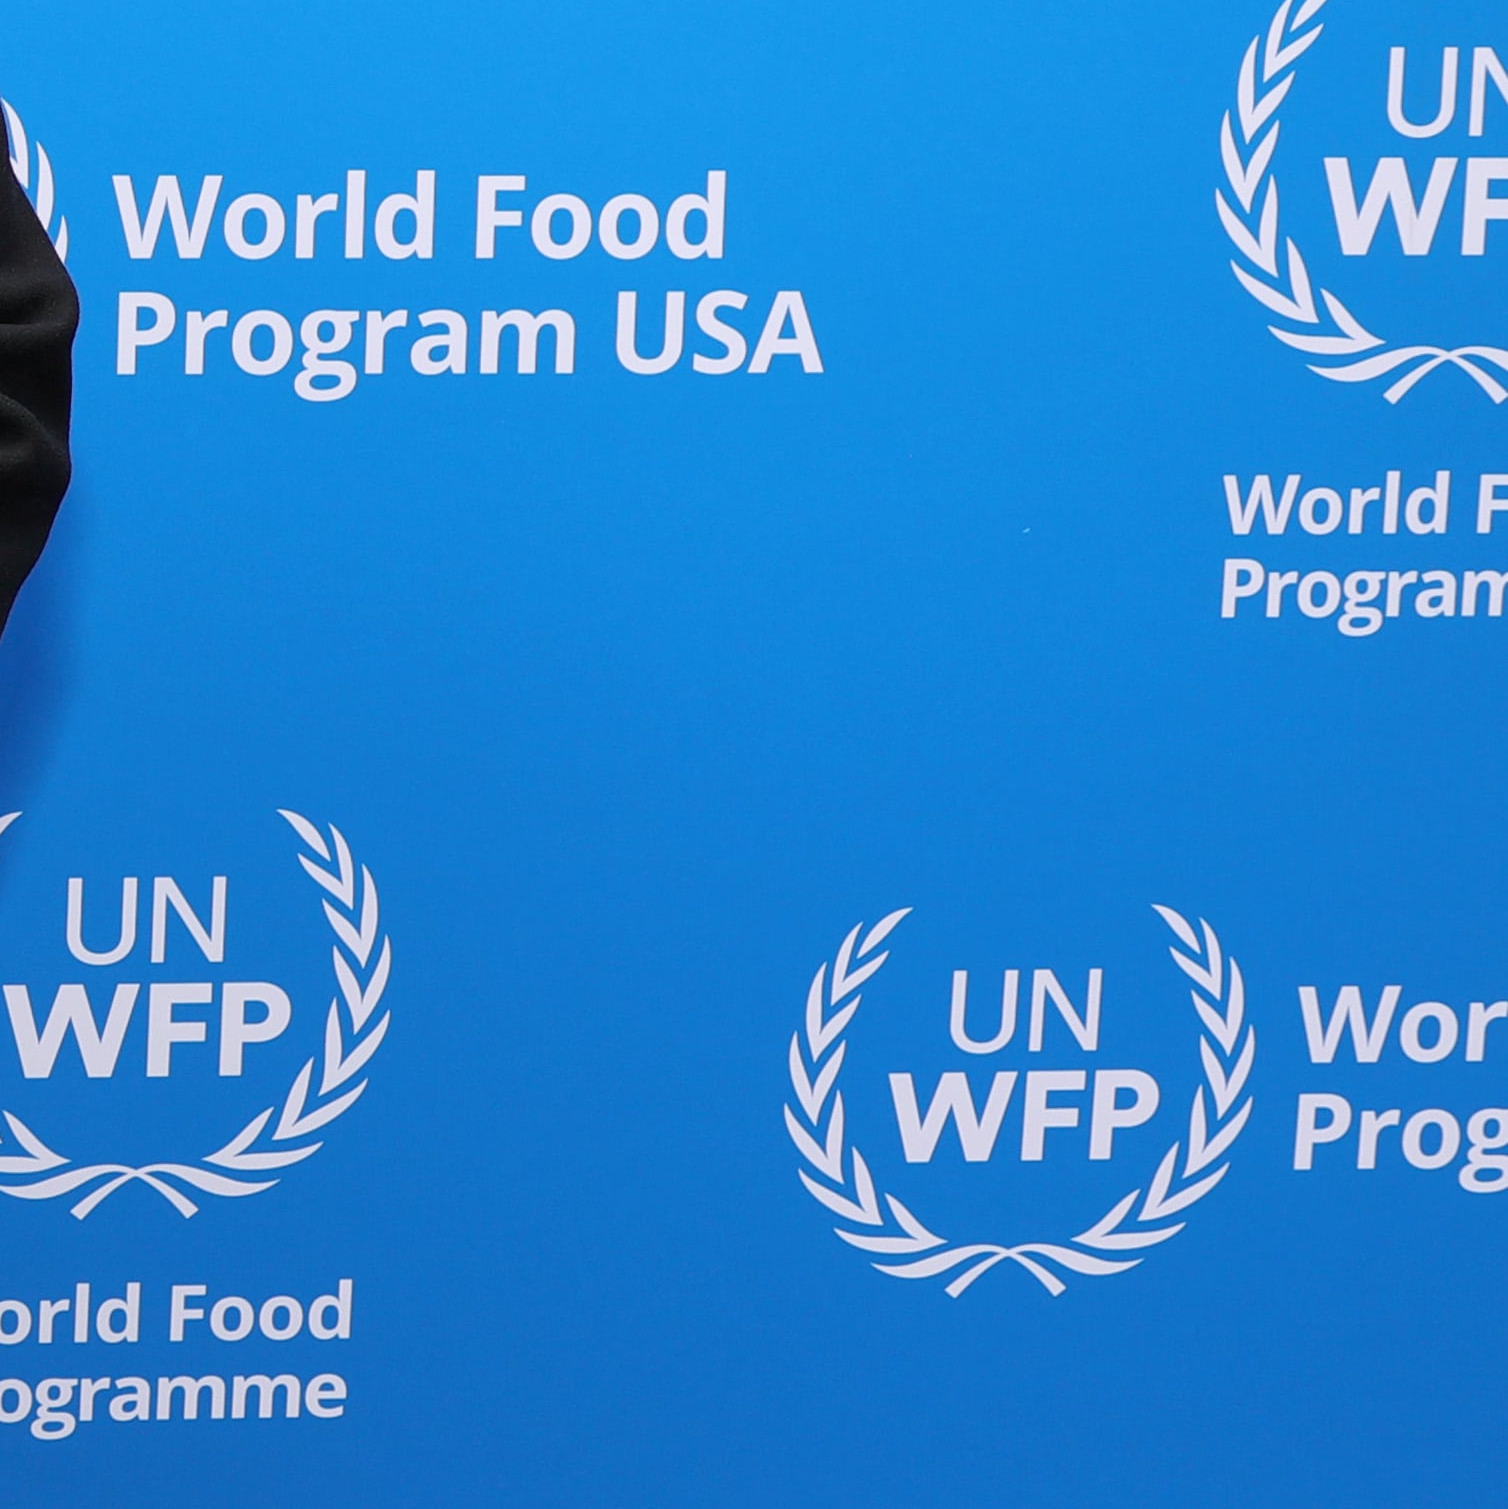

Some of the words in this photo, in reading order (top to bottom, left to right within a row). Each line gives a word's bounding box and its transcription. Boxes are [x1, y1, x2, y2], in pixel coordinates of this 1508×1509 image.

[1387, 47, 1508, 138] UN
[112, 170, 435, 259] World
[476, 170, 726, 259] Food
[117, 292, 575, 401] Program
[616, 290, 823, 374] USA
[1224, 471, 1450, 534] World
[67, 876, 226, 965] UN
[3, 982, 291, 1078] WFP
[950, 969, 1102, 1053] UN
[889, 1070, 1159, 1162] WFP
[170, 1279, 352, 1341] Food
